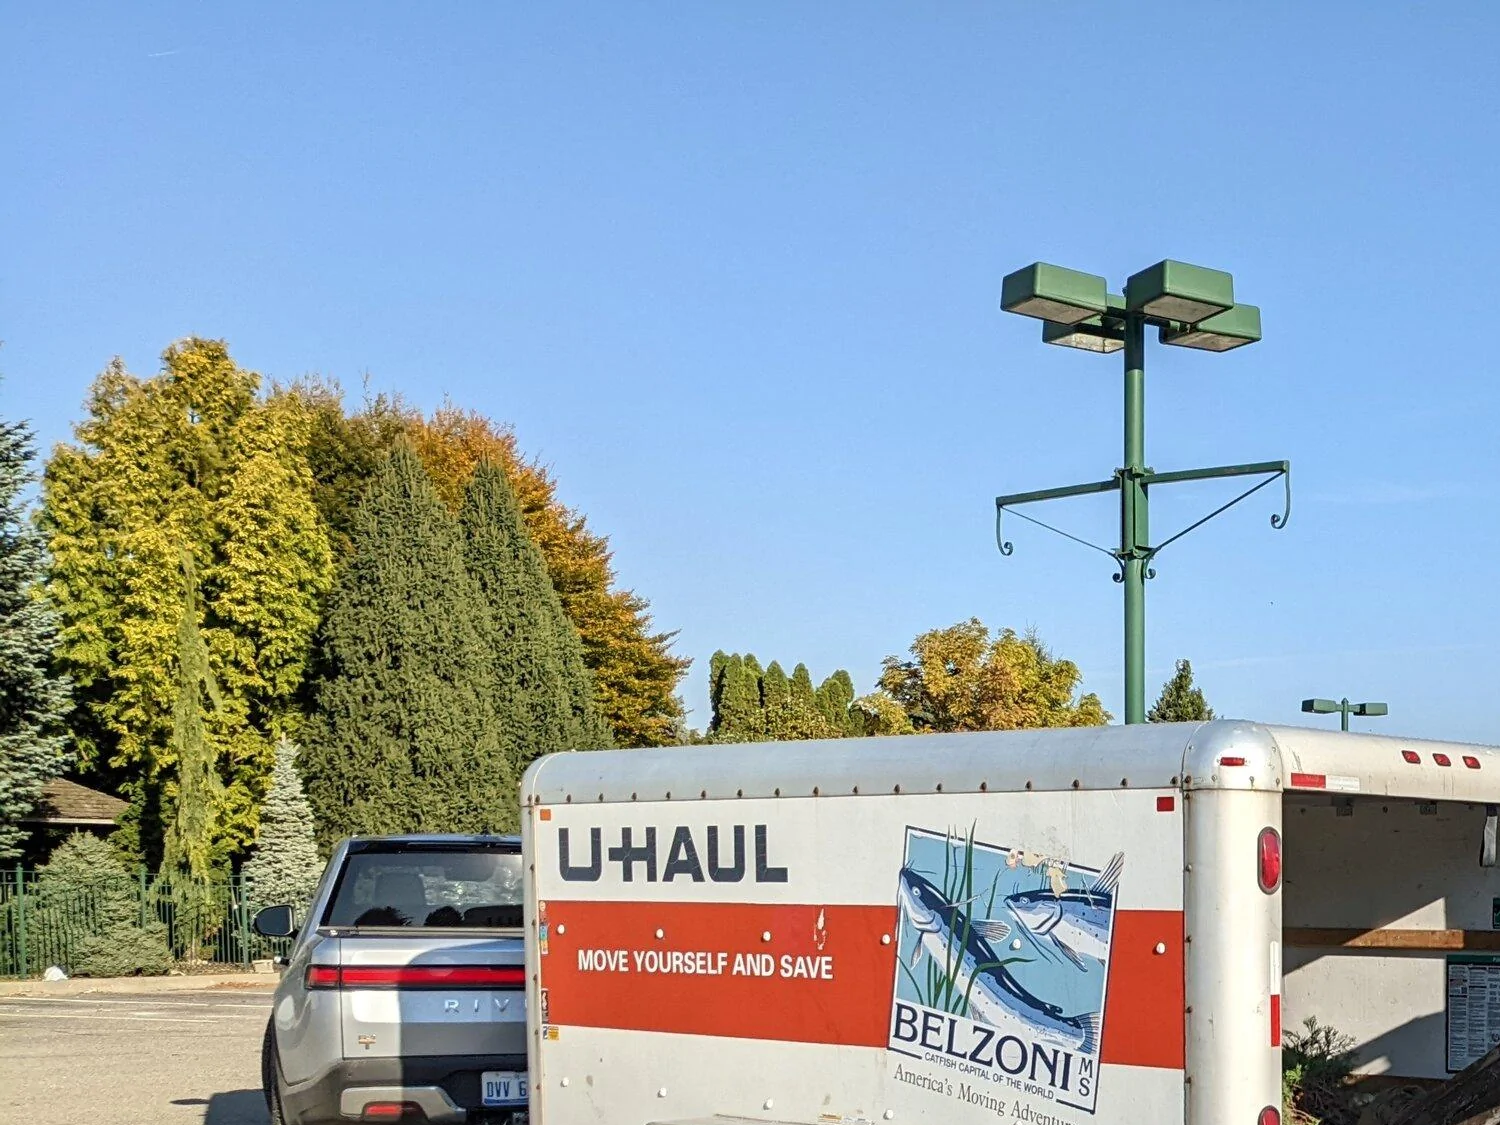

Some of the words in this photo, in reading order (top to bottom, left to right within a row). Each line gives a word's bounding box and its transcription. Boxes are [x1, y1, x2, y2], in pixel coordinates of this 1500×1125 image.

[558, 824, 788, 882] U-HAUL
[578, 950, 628, 972] MOVE
[634, 951, 728, 975] YOURSELF
[732, 953, 775, 977] AND
[780, 954, 833, 980] SAVE
[444, 999, 528, 1013] RIV
[893, 1002, 1074, 1092] BELZONI
[486, 1081, 510, 1097] DVV
[893, 1063, 953, 1096] America's
[957, 1083, 1006, 1117] Moving
[924, 1052, 957, 1069] CATFISH
[958, 1062, 990, 1081] CAPITAL
[993, 1073, 1004, 1084] OF
[1006, 1077, 1022, 1090] THE
[1024, 1083, 1054, 1100] WORLD
